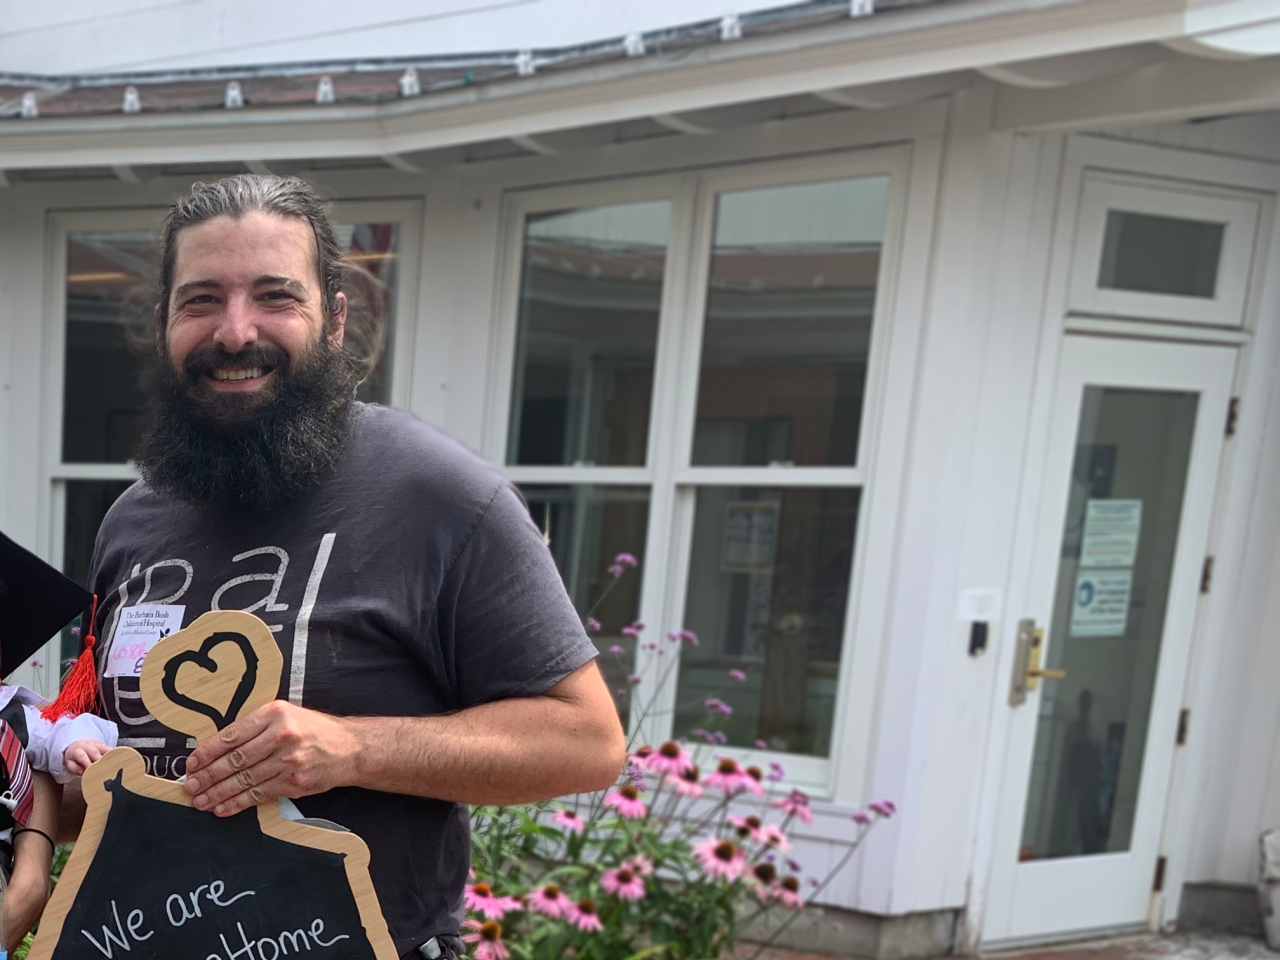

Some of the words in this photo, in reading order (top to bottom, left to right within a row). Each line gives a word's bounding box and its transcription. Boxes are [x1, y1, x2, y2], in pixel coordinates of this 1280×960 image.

[154, 610, 169, 618] Bush
[143, 620, 166, 628] Hospital
[81, 899, 154, 960] We
[166, 877, 255, 926] are
